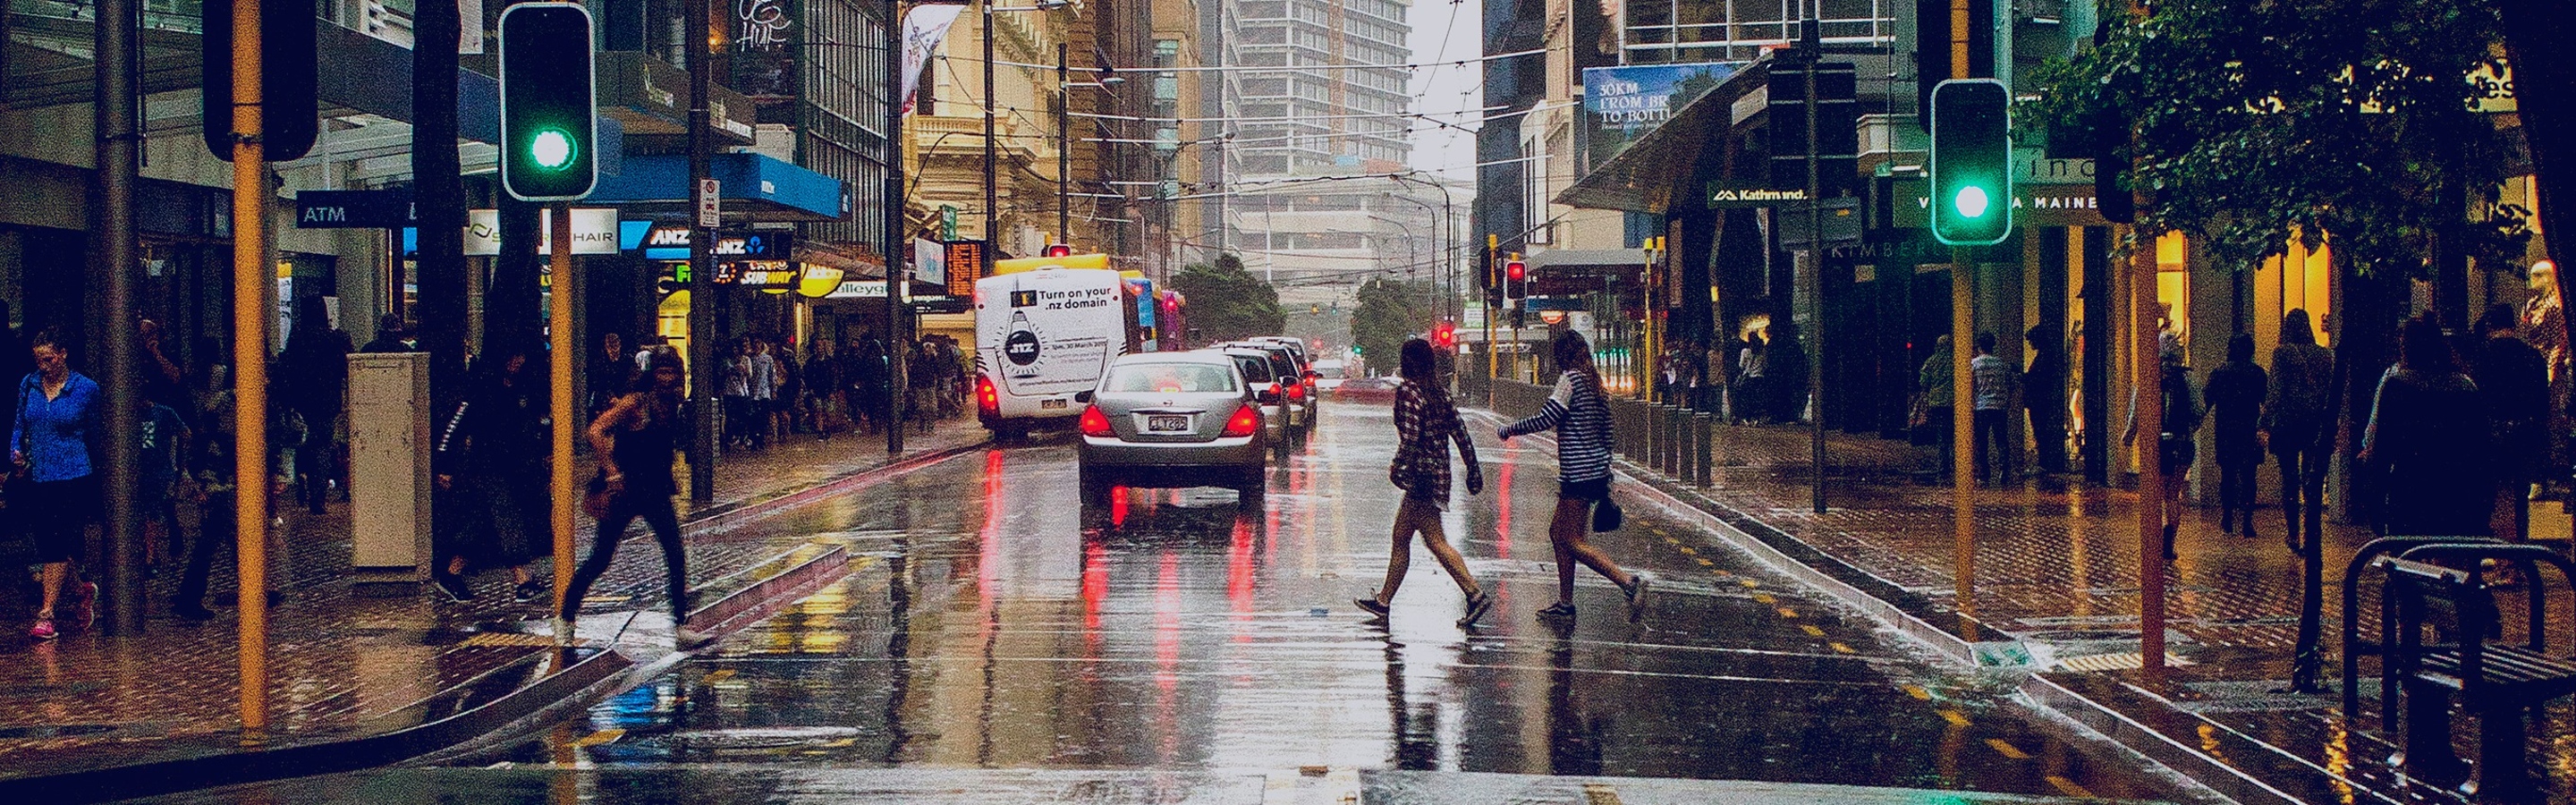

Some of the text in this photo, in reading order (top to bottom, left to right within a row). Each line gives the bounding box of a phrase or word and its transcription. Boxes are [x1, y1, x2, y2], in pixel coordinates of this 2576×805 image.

[1600, 110, 1622, 123] TO
[1740, 190, 1808, 201] Kathmnd
[2034, 197, 2097, 208] MAINE
[303, 207, 346, 222] ATM
[573, 233, 614, 242] HAIR
[649, 229, 691, 245] ANZ
[741, 270, 798, 284] SUBWAY
[1038, 287, 1111, 301] Turn on your
[1045, 298, 1107, 310] .nz domain
